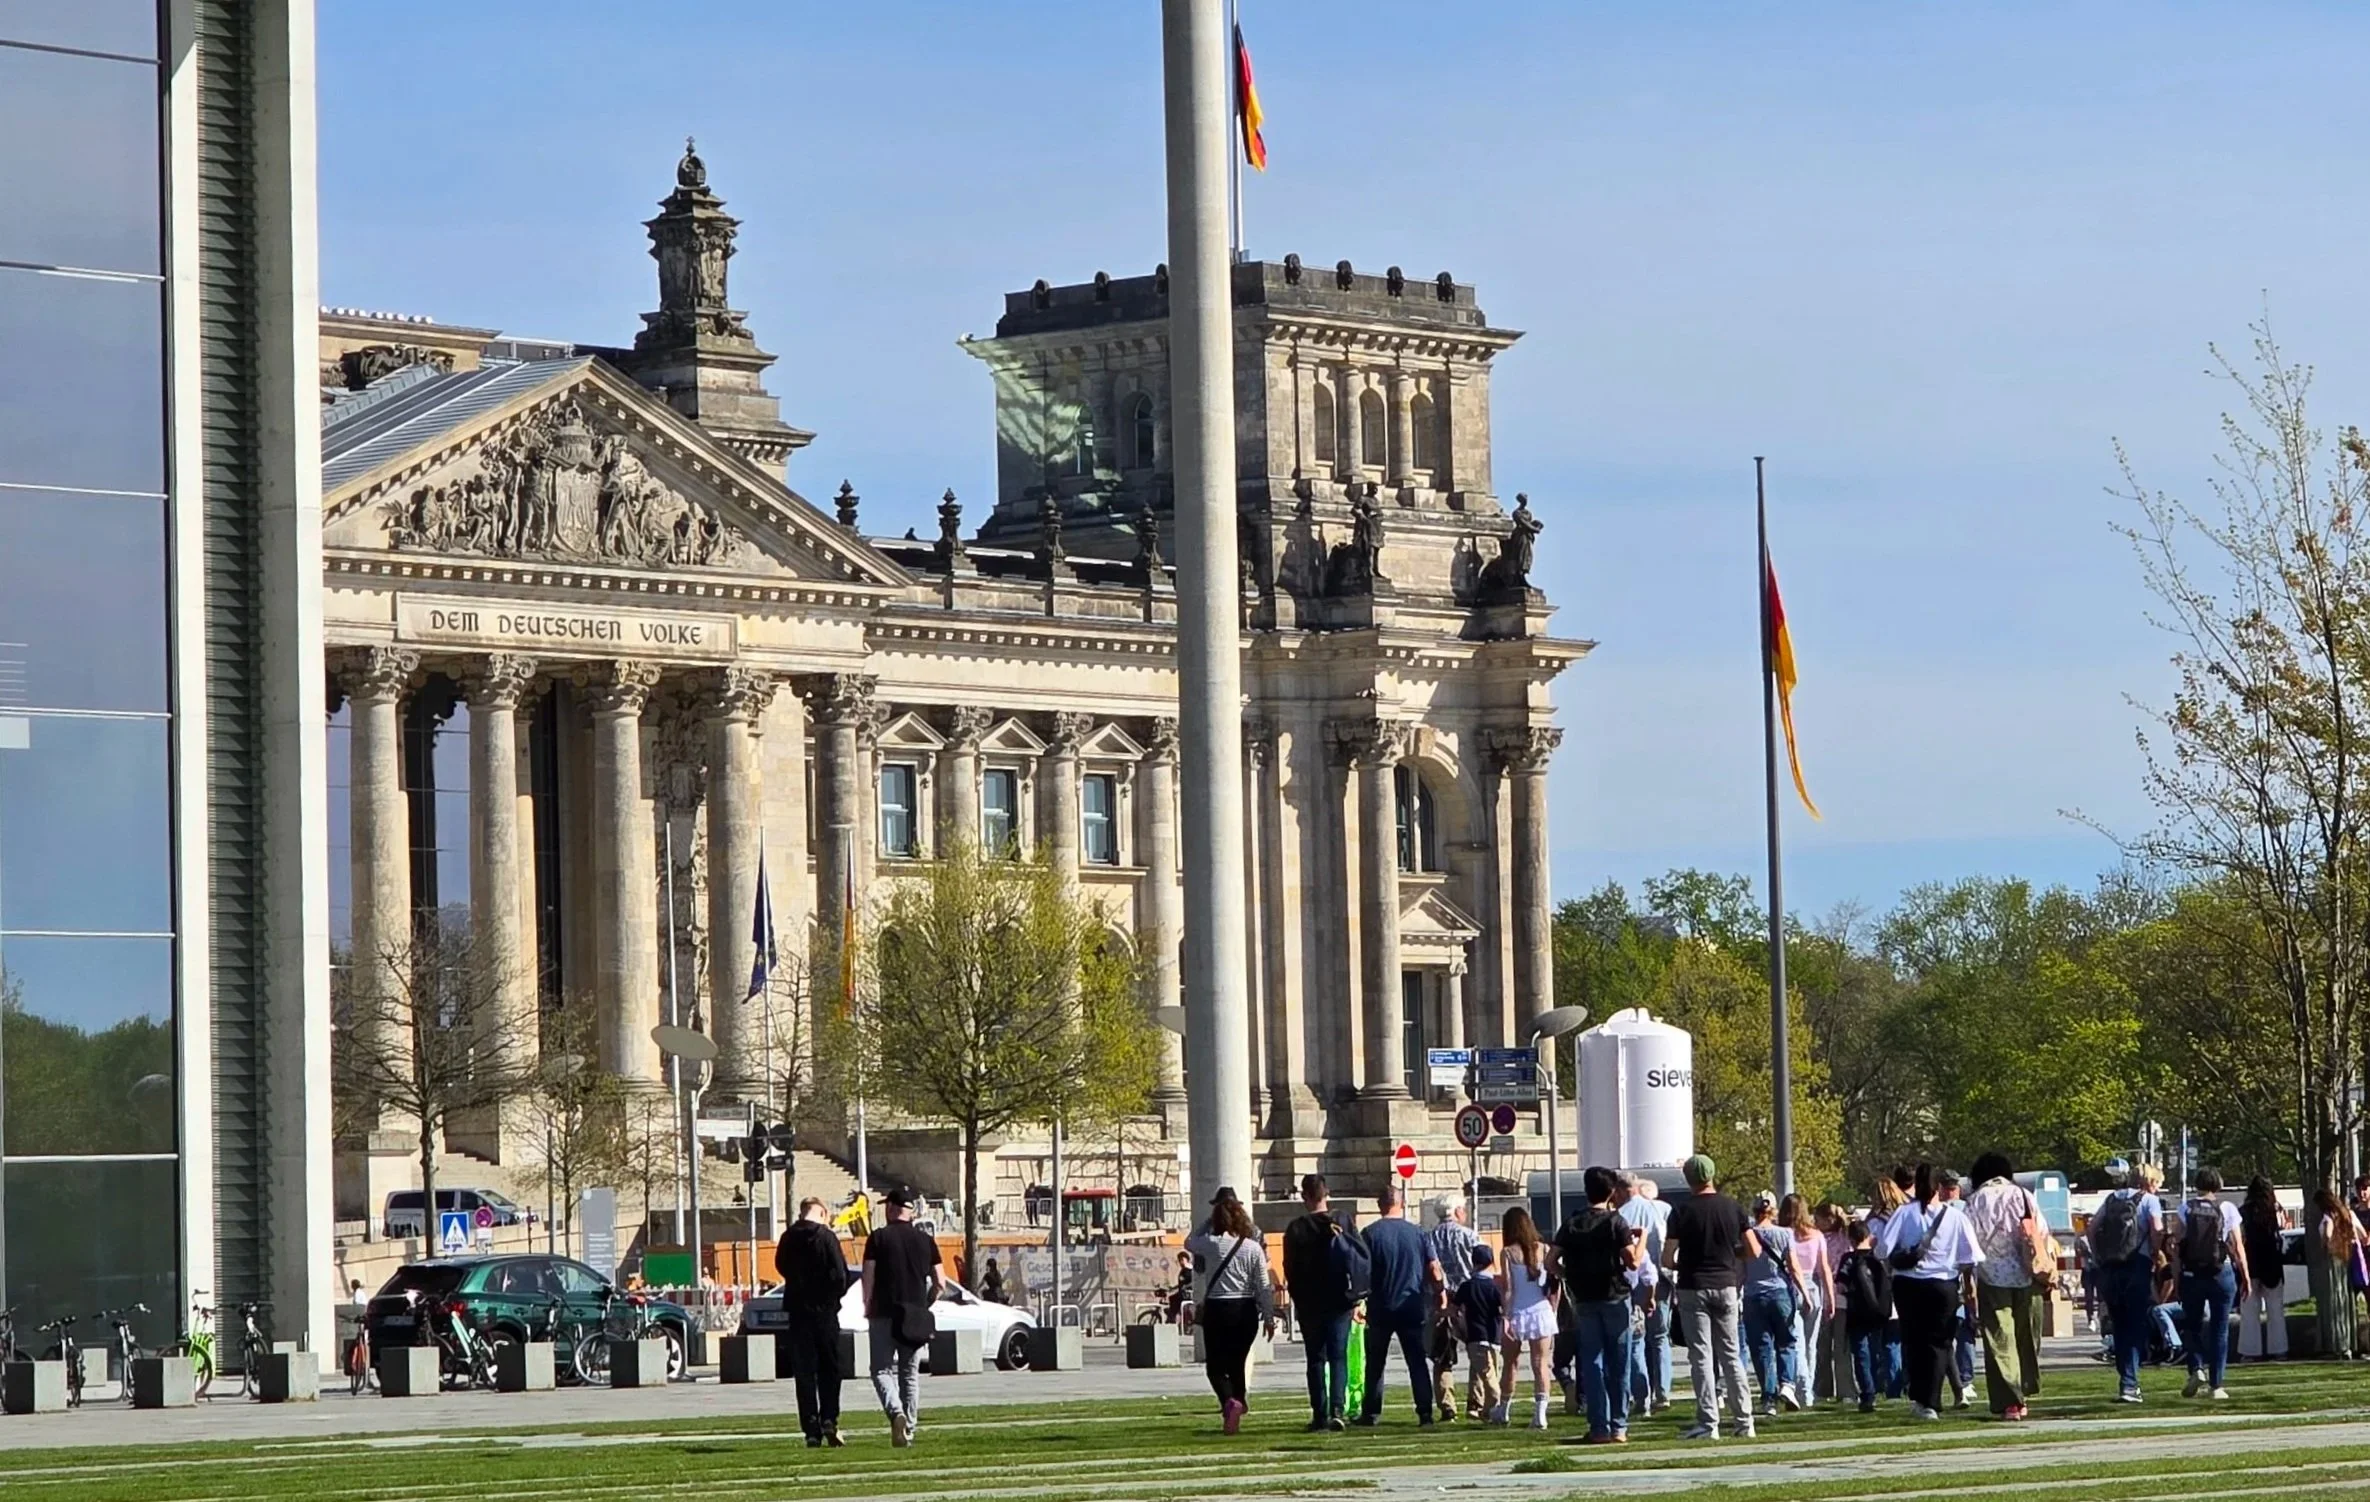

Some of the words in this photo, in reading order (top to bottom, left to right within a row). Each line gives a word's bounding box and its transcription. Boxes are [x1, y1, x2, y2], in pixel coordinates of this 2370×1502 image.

[430, 610, 479, 632] DEM
[498, 614, 621, 641] DEUTSCHEN
[640, 622, 701, 645] VOLKE
[1463, 1116, 1482, 1136] 50
